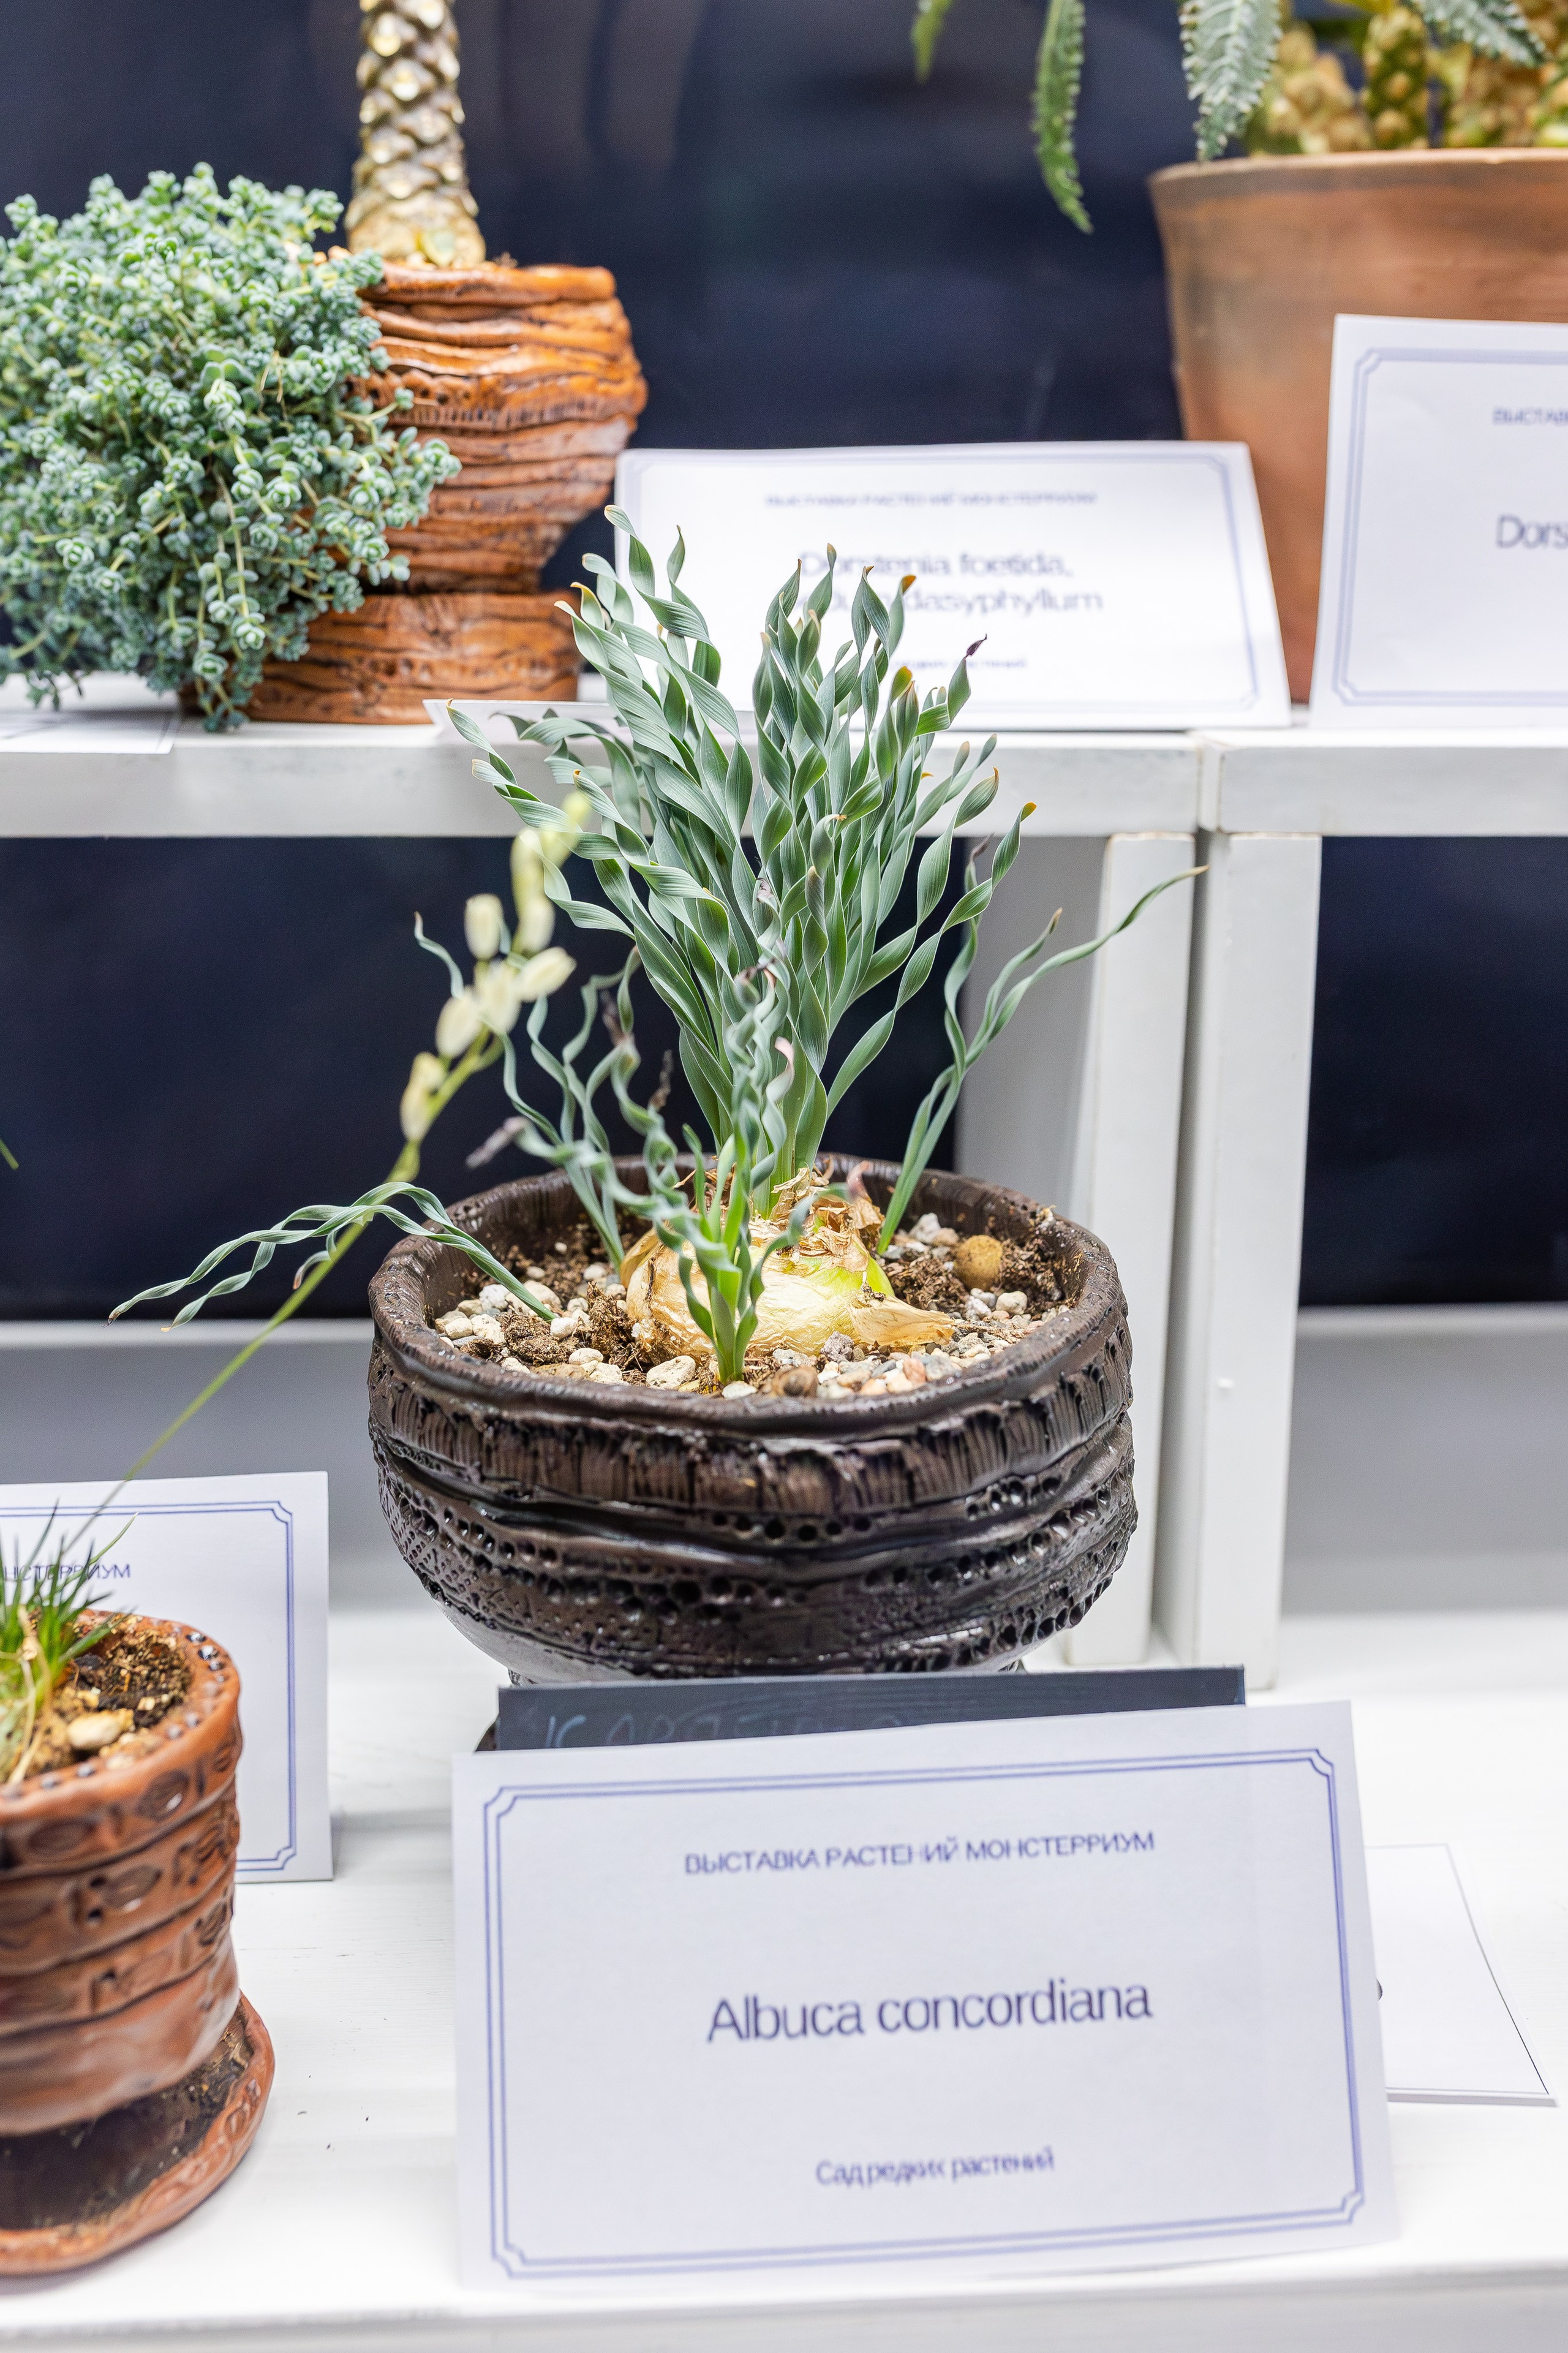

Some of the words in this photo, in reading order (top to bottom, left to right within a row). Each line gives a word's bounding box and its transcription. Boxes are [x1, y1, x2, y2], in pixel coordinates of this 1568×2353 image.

[684, 1847, 821, 1875] ВЫСТАВКА
[824, 1836, 959, 1868] РАСТЕНИЙ
[965, 1830, 1155, 1862] МОНСТЕРРИУМ
[706, 1993, 865, 2044] Albuca
[876, 1976, 1154, 2034] concordiana
